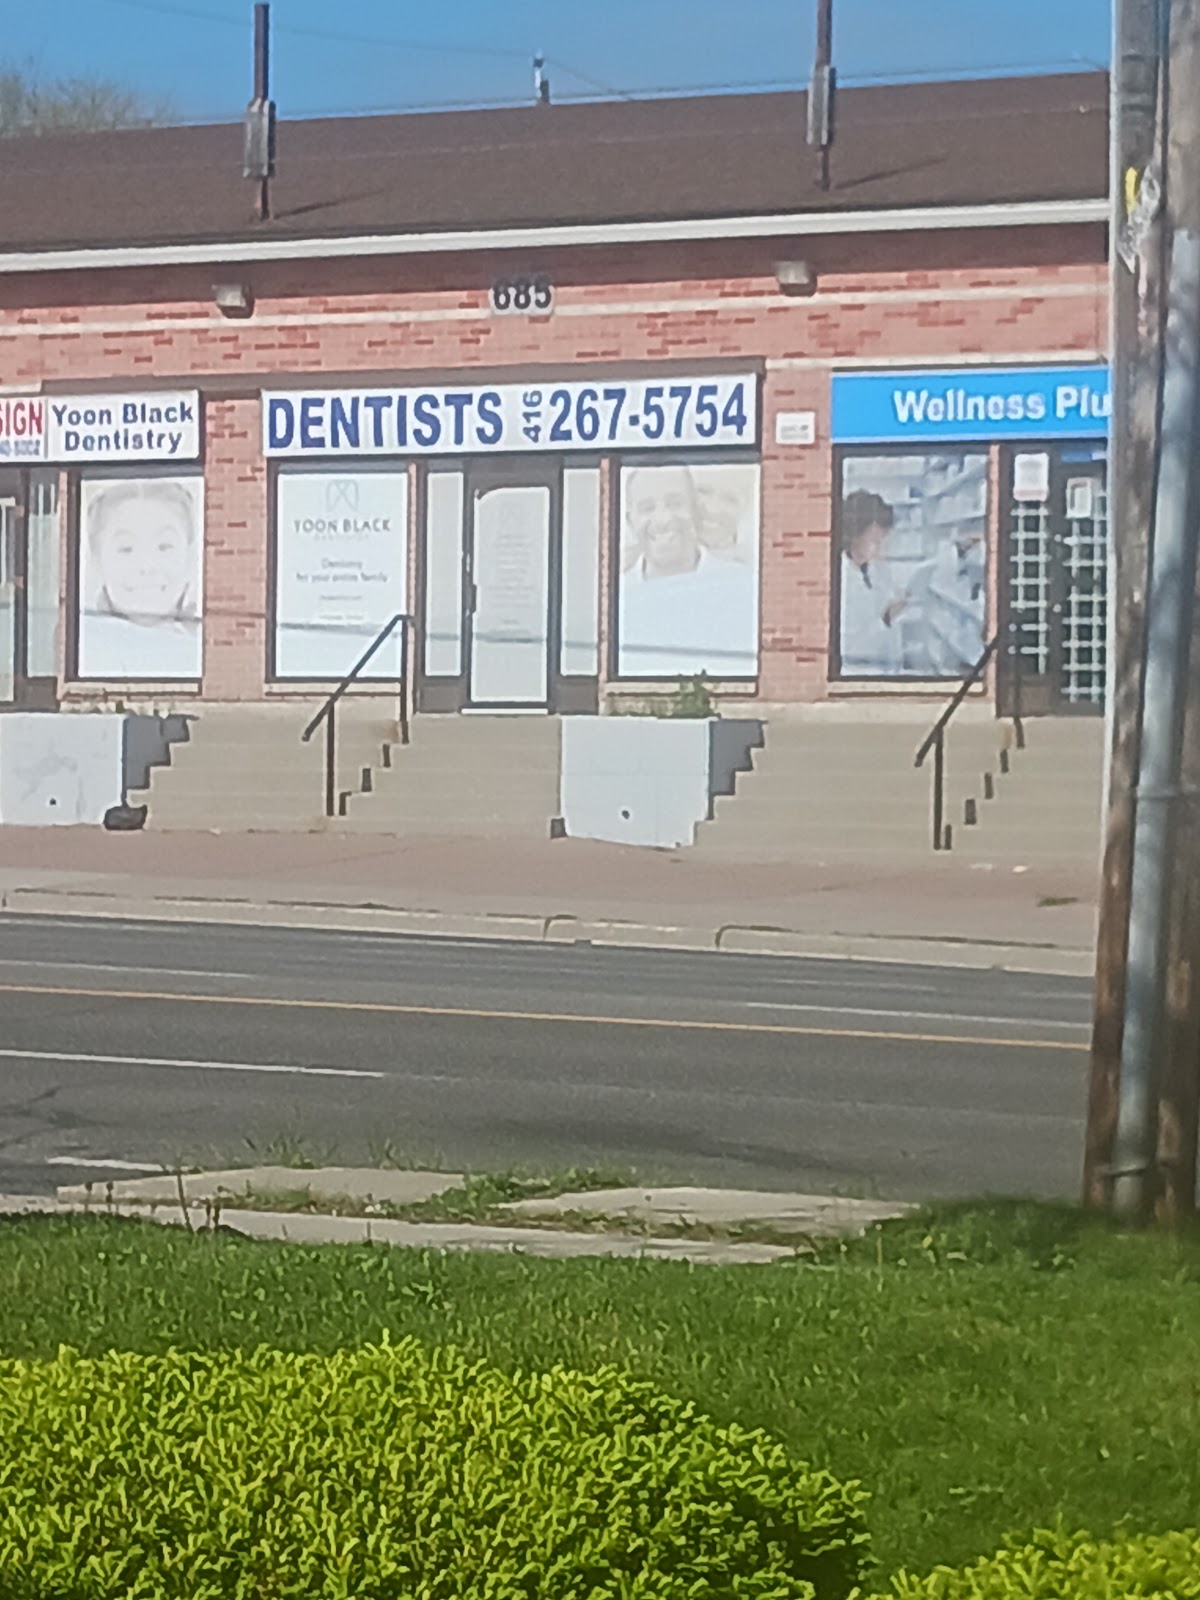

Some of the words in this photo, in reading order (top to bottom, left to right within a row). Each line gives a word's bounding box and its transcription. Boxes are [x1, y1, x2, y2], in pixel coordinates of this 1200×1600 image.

[493, 274, 551, 310] 685
[0, 401, 42, 437] IGN
[52, 404, 112, 426] Yoon
[123, 401, 193, 424] Black
[269, 392, 503, 448] DENTISTS
[522, 390, 542, 443] 416
[549, 383, 747, 441] 267-5754
[893, 389, 1046, 422] Wellness
[65, 428, 182, 454] Dentistry
[294, 519, 337, 533] YOON
[343, 518, 391, 532] BLACK
